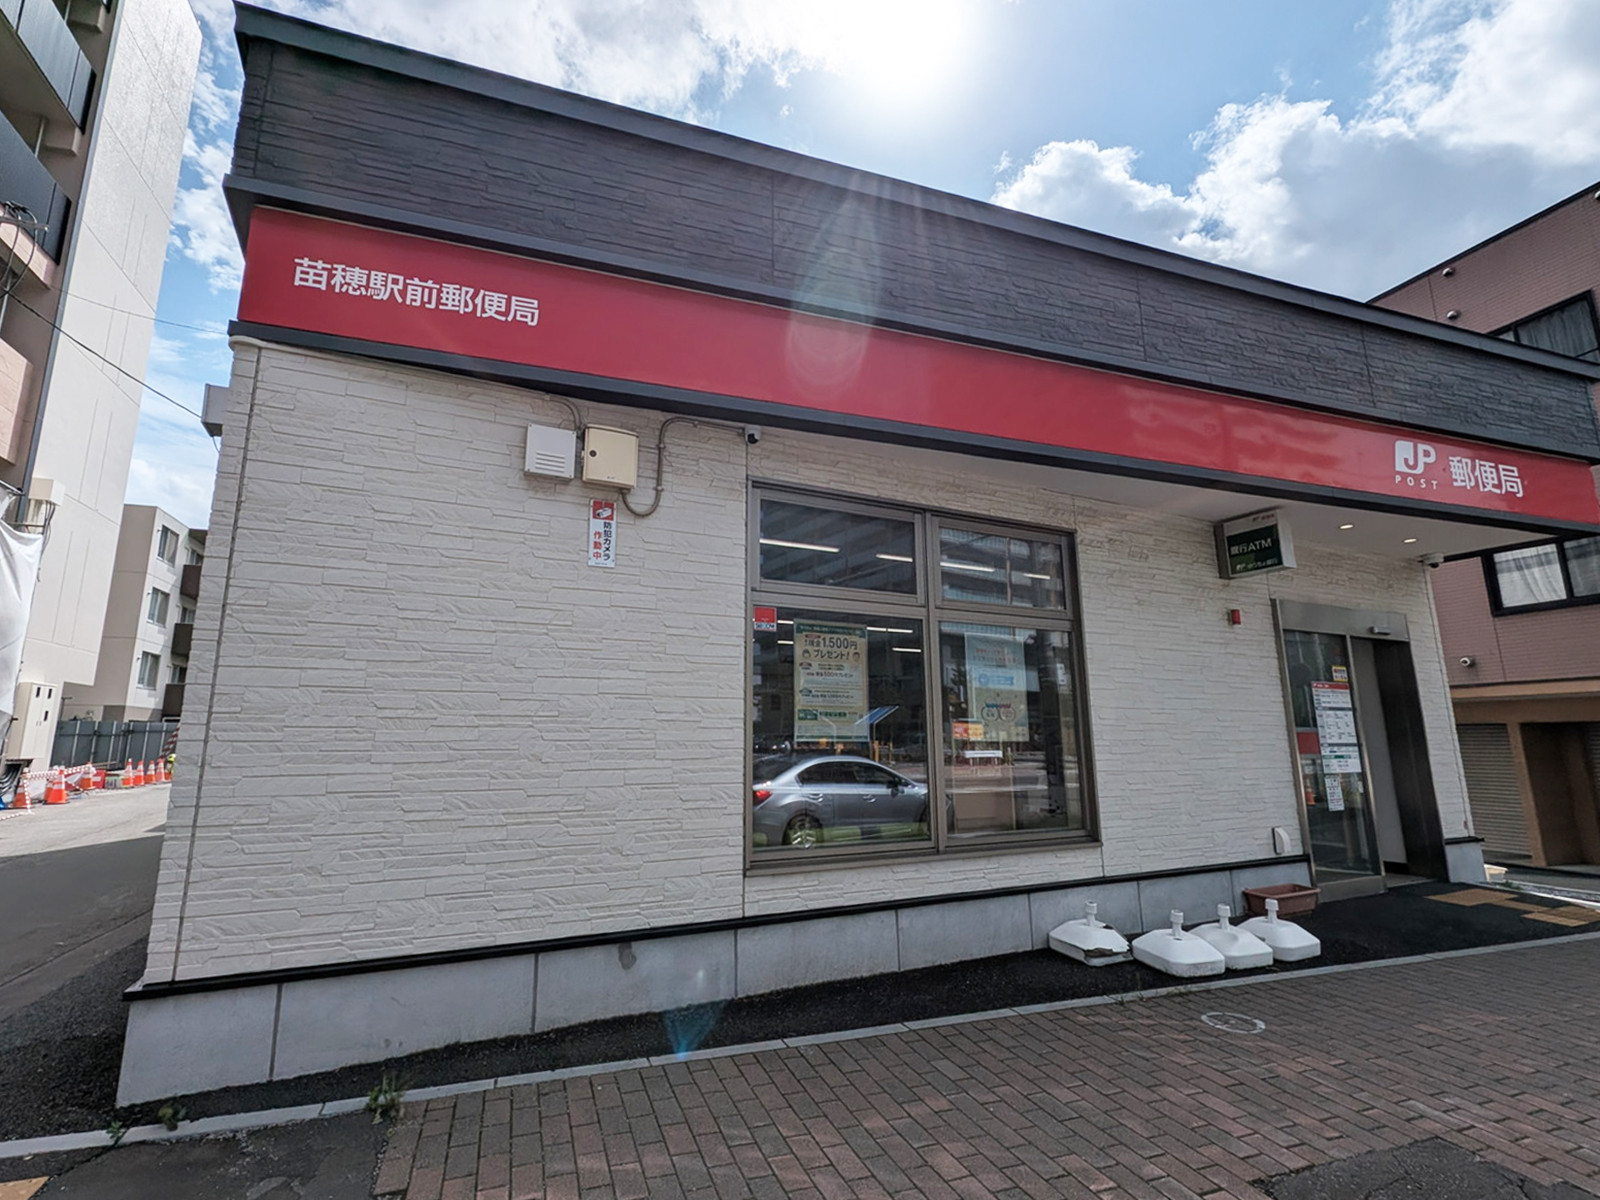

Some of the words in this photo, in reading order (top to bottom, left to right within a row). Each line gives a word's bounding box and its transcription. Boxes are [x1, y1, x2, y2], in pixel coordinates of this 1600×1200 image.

[293, 257, 540, 327] 苗穂駅前郵便局
[1395, 474, 1438, 490] POST
[1449, 456, 1523, 498] 郵便局
[602, 521, 613, 562] 防犯カメラ
